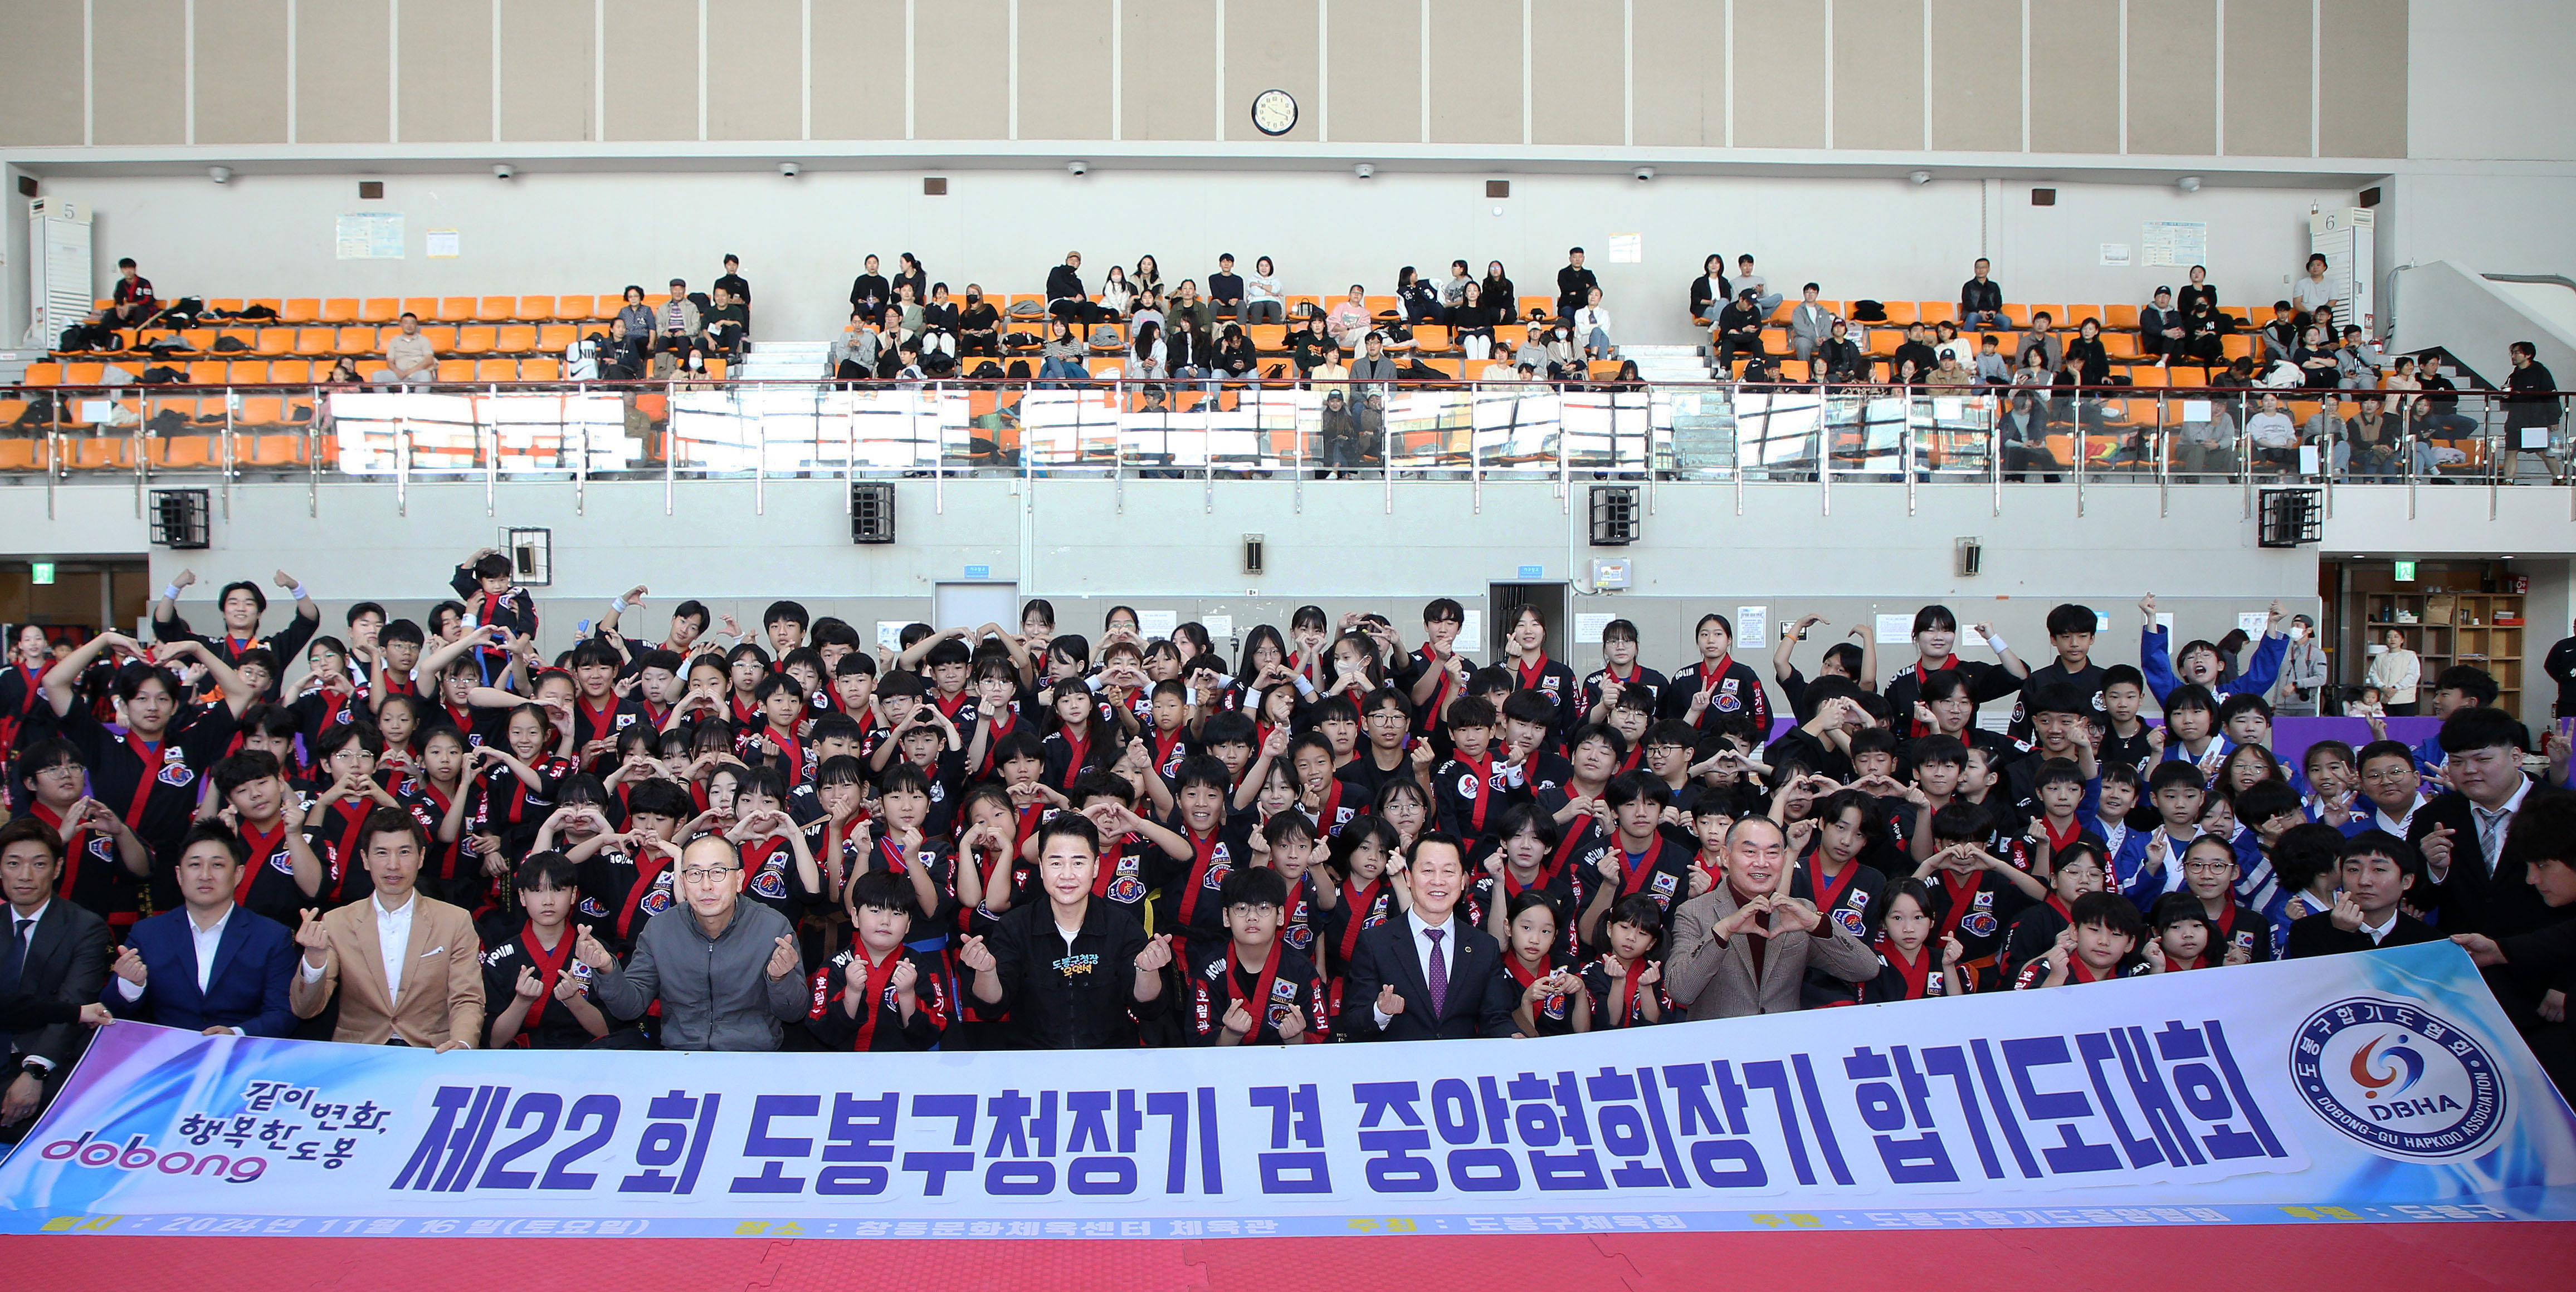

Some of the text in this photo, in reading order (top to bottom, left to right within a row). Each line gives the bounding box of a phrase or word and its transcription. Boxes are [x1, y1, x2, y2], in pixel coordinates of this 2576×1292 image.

[64, 203, 74, 219] 5
[2325, 214, 2335, 231] 6
[1675, 667, 1694, 680] HOLIM
[2014, 849, 2027, 869] 호림
[1652, 885, 1672, 895] KOREA
[1052, 953, 1100, 970] 도봉구청장
[1205, 958, 1227, 981] HOLIM
[1196, 988, 1210, 1031] 호림관
[1313, 985, 1329, 1030] 합기도
[245, 1080, 311, 1112] 같이
[728, 1088, 1223, 1197] 도봉구청장기
[1249, 1084, 1334, 1195] 겸
[1352, 1053, 1855, 1193] 중앙협회장기
[1842, 1020, 2289, 1184] 합기도대회
[2316, 1071, 2493, 1149] DOBONG-GU HAPKIDO ASSOCIATION
[2367, 1094, 2463, 1122] DBHA
[178, 1113, 357, 1171] 행복한 도봉
[41, 1132, 267, 1185] dobong
[1747, 1213, 1824, 1227] 주관
[1863, 1207, 2231, 1226] 도봉구합기도중앙협회
[2277, 1206, 2365, 1221] 후원
[2389, 1204, 2507, 1219] 도봉구
[40, 1215, 125, 1231] 일시
[158, 1216, 306, 1234] 2024년
[316, 1218, 406, 1234] 11월
[734, 1221, 806, 1235] 장소
[855, 1221, 1152, 1236] 창동문화체육센터
[1169, 1220, 1279, 1235] 체육관
[1346, 1217, 1417, 1232] 주최
[1465, 1214, 1687, 1231] 도봉구체육회
